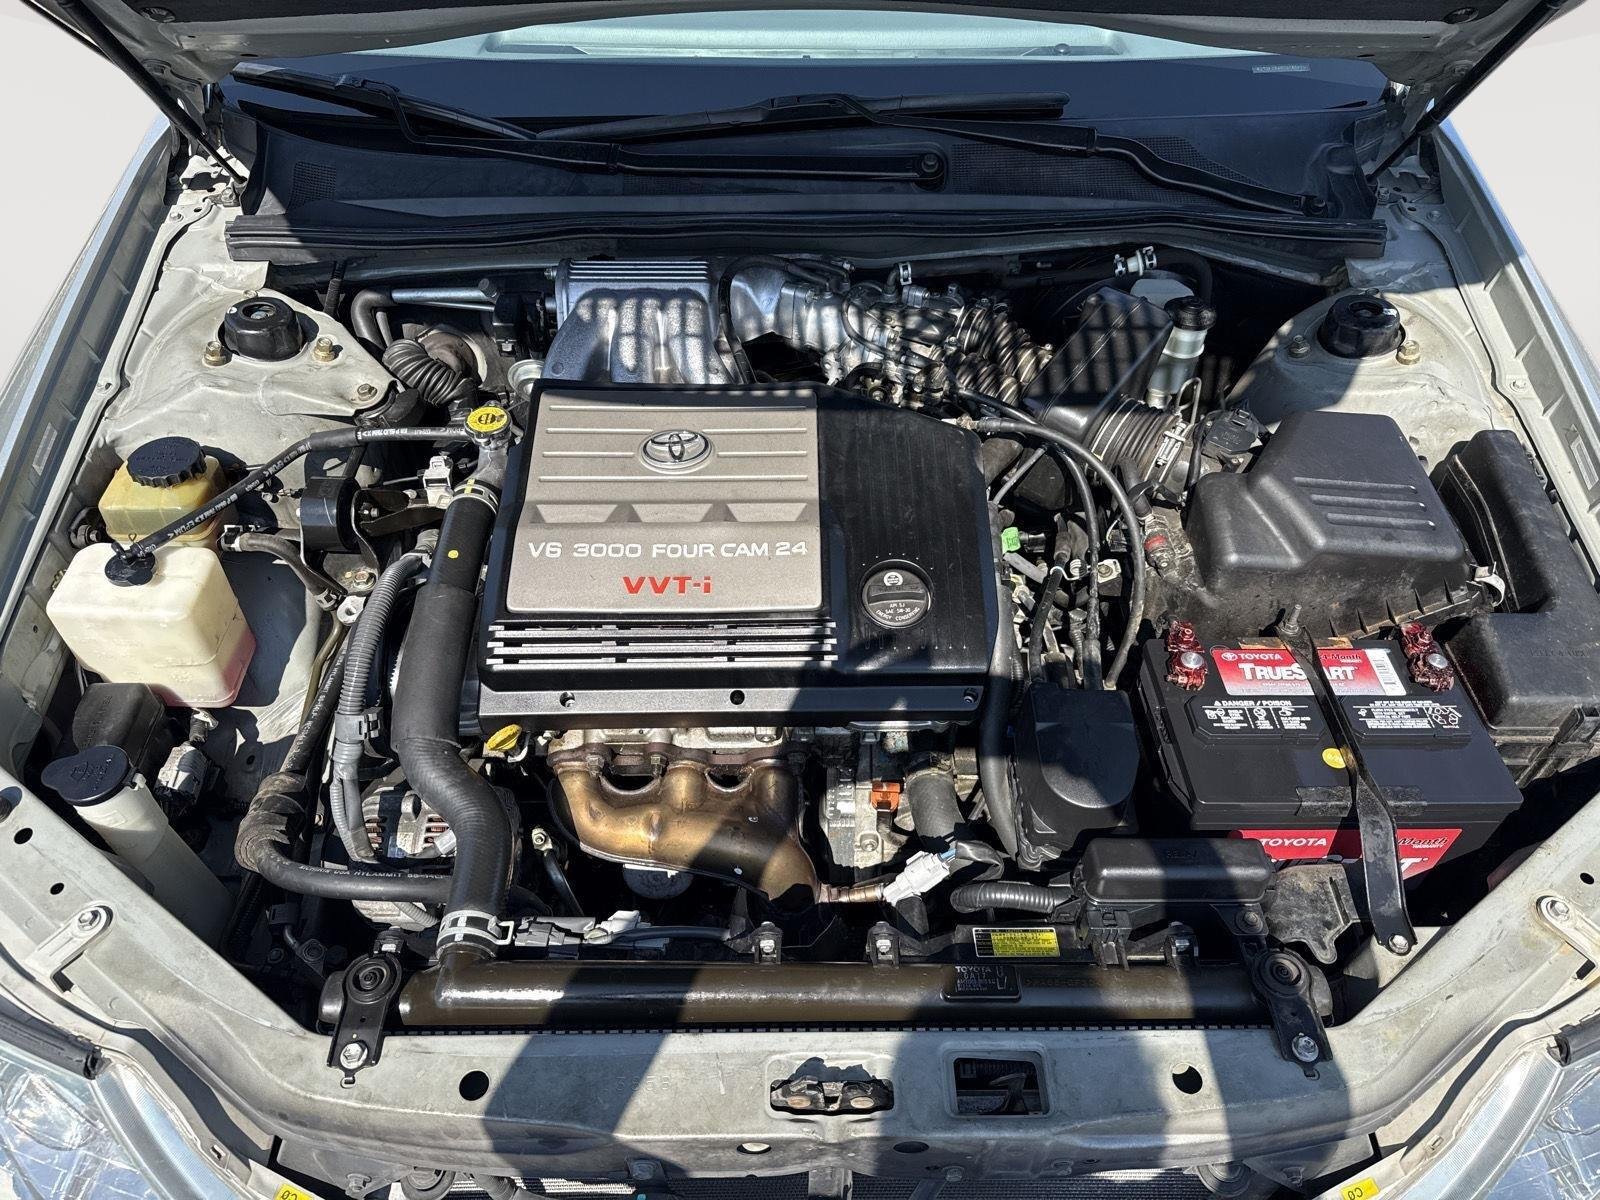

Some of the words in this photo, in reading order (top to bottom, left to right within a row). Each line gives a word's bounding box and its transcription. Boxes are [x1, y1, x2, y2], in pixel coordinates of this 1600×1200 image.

[528, 542, 562, 558] V6
[573, 543, 642, 558] 3000
[652, 543, 715, 558] FOUR
[720, 542, 769, 557] CAM
[775, 541, 809, 556] 24
[621, 576, 713, 594] VVT-i
[1237, 653, 1283, 661] TOYOTA
[1261, 838, 1327, 847] TOYOTA
